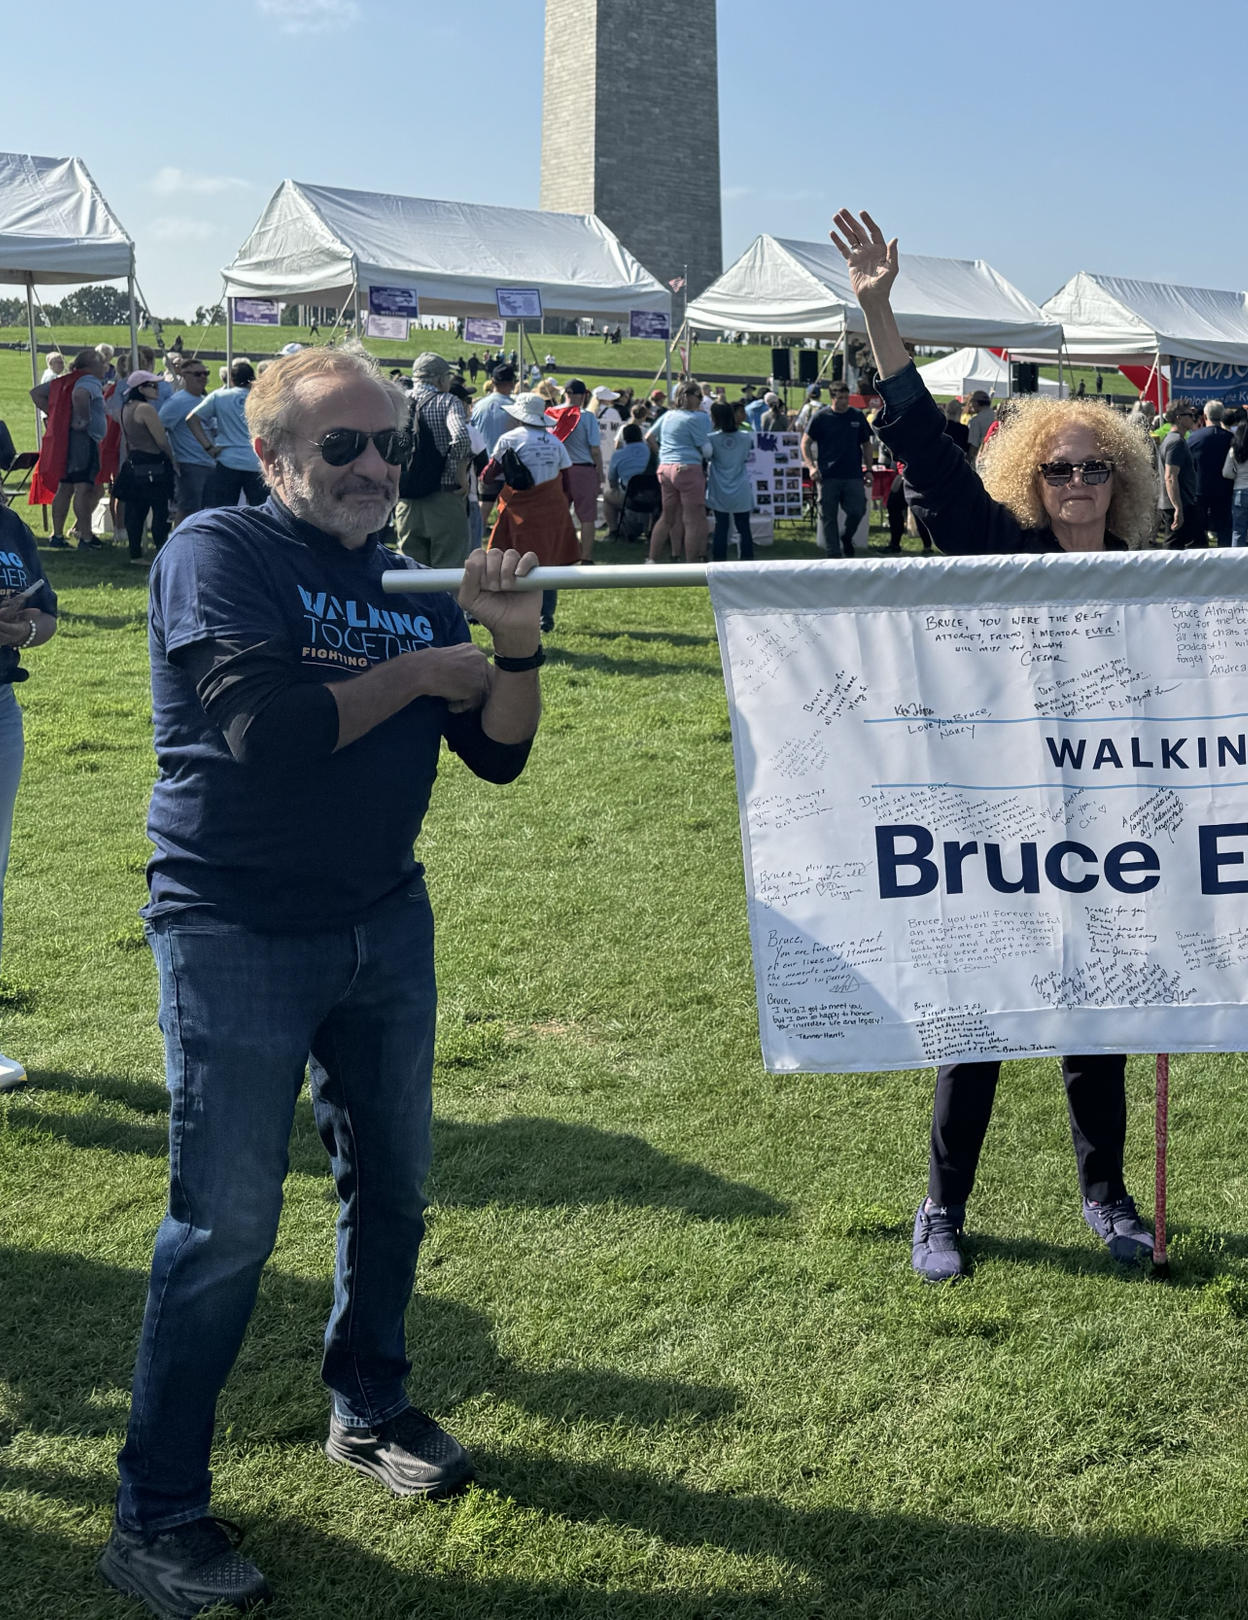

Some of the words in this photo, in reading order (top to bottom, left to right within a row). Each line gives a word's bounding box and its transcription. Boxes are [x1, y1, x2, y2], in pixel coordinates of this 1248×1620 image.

[1175, 358, 1225, 380] TEAM
[296, 584, 434, 642] WALKING
[979, 618, 1001, 627] YOU
[1012, 616, 1040, 625] WERE
[1048, 614, 1068, 624] THE
[1074, 612, 1109, 622] BEST
[1171, 605, 1200, 619] Bruce
[1174, 621, 1191, 632] you
[1195, 621, 1210, 629] for
[1215, 617, 1231, 625] the
[1040, 629, 1080, 638] MENTOR
[1176, 631, 1187, 642] all
[1192, 630, 1208, 641] the
[1212, 626, 1240, 638] chats
[302, 646, 368, 668] FIGHTING
[1176, 653, 1204, 668] forget
[1210, 663, 1247, 676] Andrea
[907, 723, 934, 735] Love
[874, 824, 1161, 899] Bruce
[947, 915, 967, 928] you
[969, 911, 990, 920] will
[992, 910, 1035, 919] forever
[1019, 917, 1061, 930] grateful
